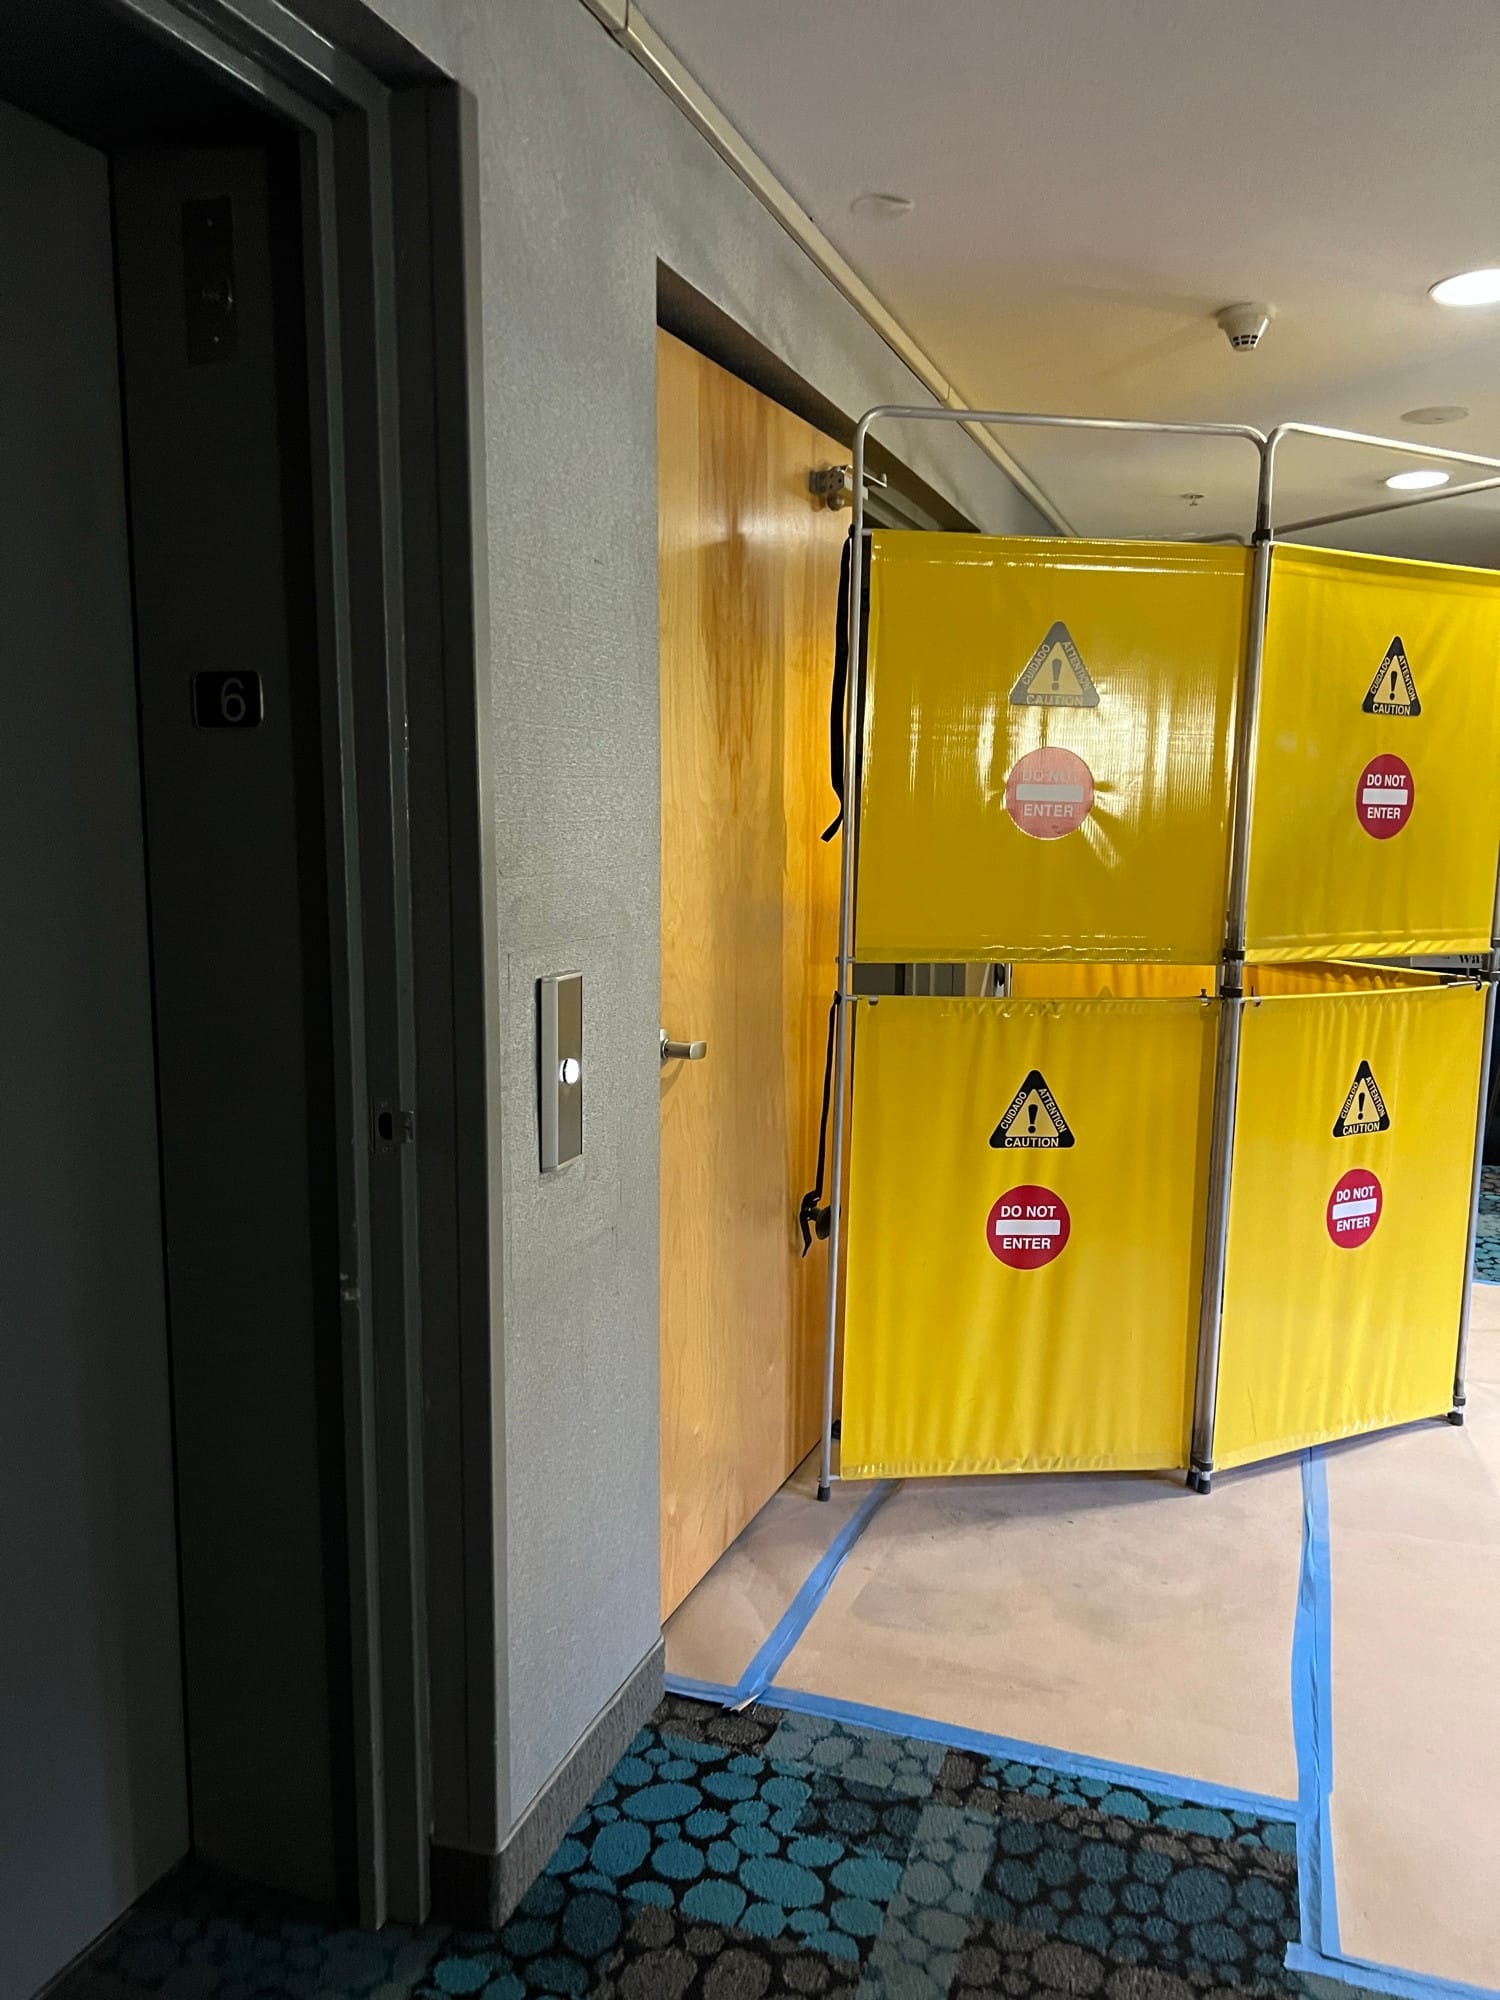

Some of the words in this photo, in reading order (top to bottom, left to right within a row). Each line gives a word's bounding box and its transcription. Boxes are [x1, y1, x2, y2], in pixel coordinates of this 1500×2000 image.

[1020, 644, 1050, 686] CUIDADO
[1062, 641, 1092, 691] ATTENTION
[1370, 657, 1390, 694] CUIDADO
[1398, 655, 1416, 702] ATTENTION
[221, 678, 246, 722] 6
[1026, 694, 1082, 706] CAUTION
[1372, 703, 1410, 716] CAUTION
[1367, 773, 1382, 786] DO
[1384, 774, 1406, 787] NOT
[1024, 803, 1073, 817] ENTER
[1367, 806, 1400, 819] ENTER
[1340, 1081, 1359, 1119] CUIDADO
[1366, 1076, 1386, 1118] ATTENTION
[1000, 1091, 1027, 1130] CUIDADO
[1038, 1088, 1067, 1133] ATTENTION
[1342, 1122, 1380, 1136] CAUTION
[1004, 1137, 1059, 1147] CAUTION
[1336, 1189, 1351, 1203] DO
[1353, 1185, 1376, 1199] NOT
[1001, 1205, 1022, 1218] DO
[1026, 1205, 1057, 1218] NOT
[1336, 1216, 1371, 1232] ENTER
[1002, 1237, 1052, 1250] ENTER
